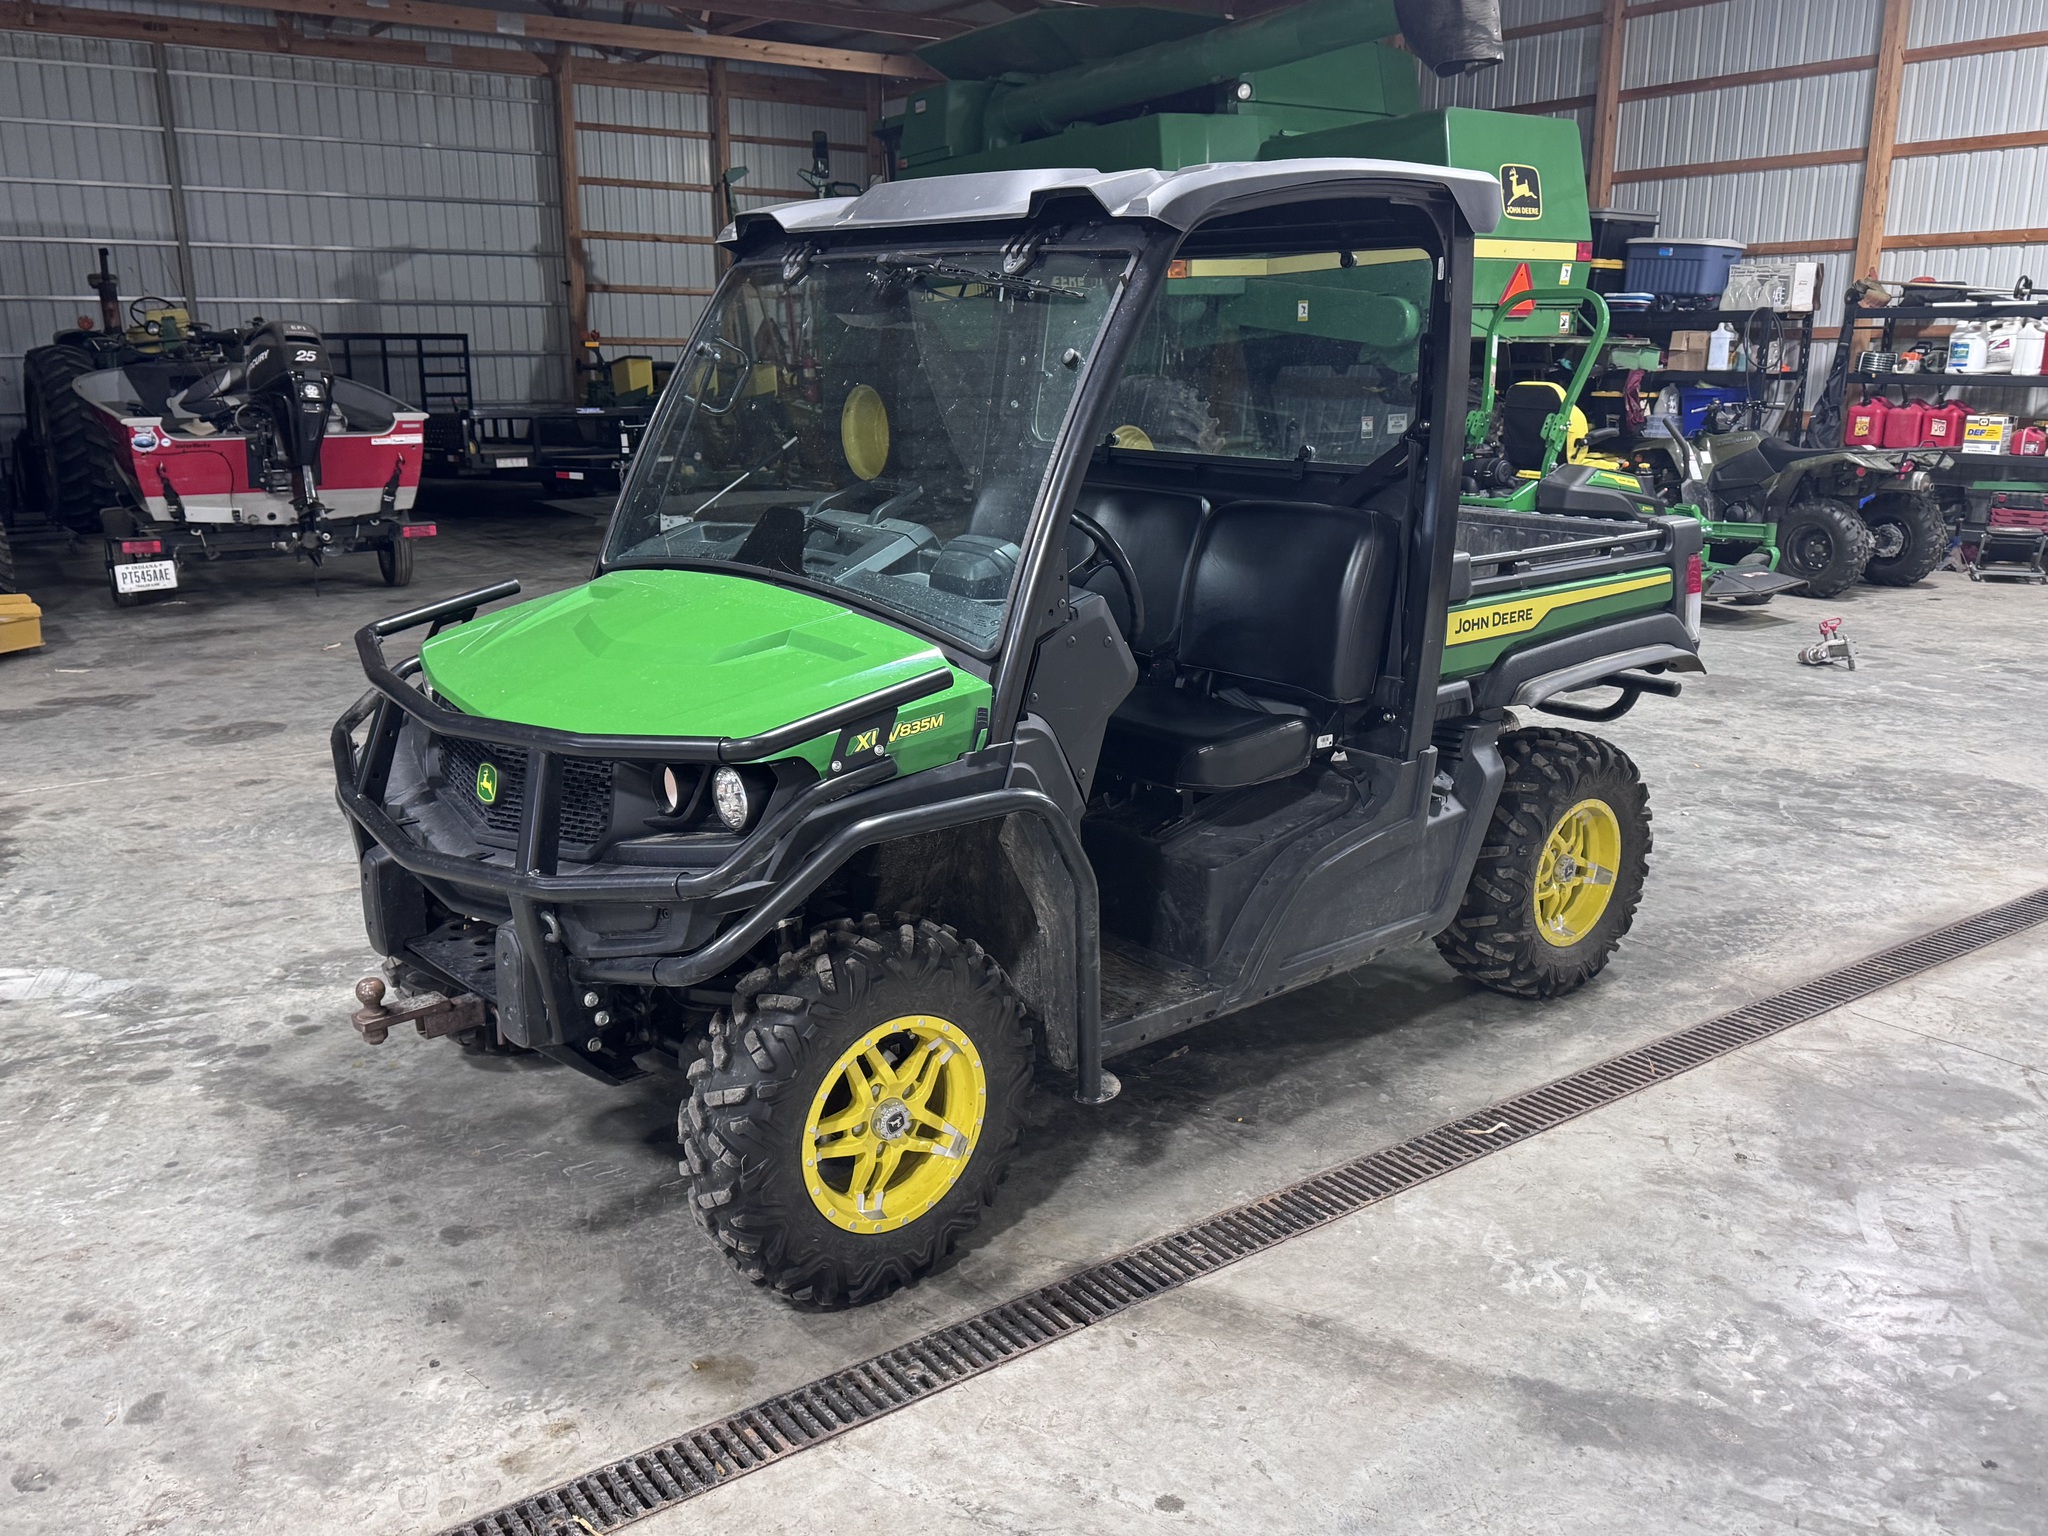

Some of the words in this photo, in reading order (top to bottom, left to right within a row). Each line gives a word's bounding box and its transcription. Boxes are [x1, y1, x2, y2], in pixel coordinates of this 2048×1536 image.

[1507, 206, 1521, 214] JOHN
[1522, 207, 1539, 215] DEERE
[294, 350, 317, 362] 25
[121, 568, 171, 585] PT545AAE
[1455, 616, 1489, 635] JOHN
[1493, 608, 1534, 627] DEERE
